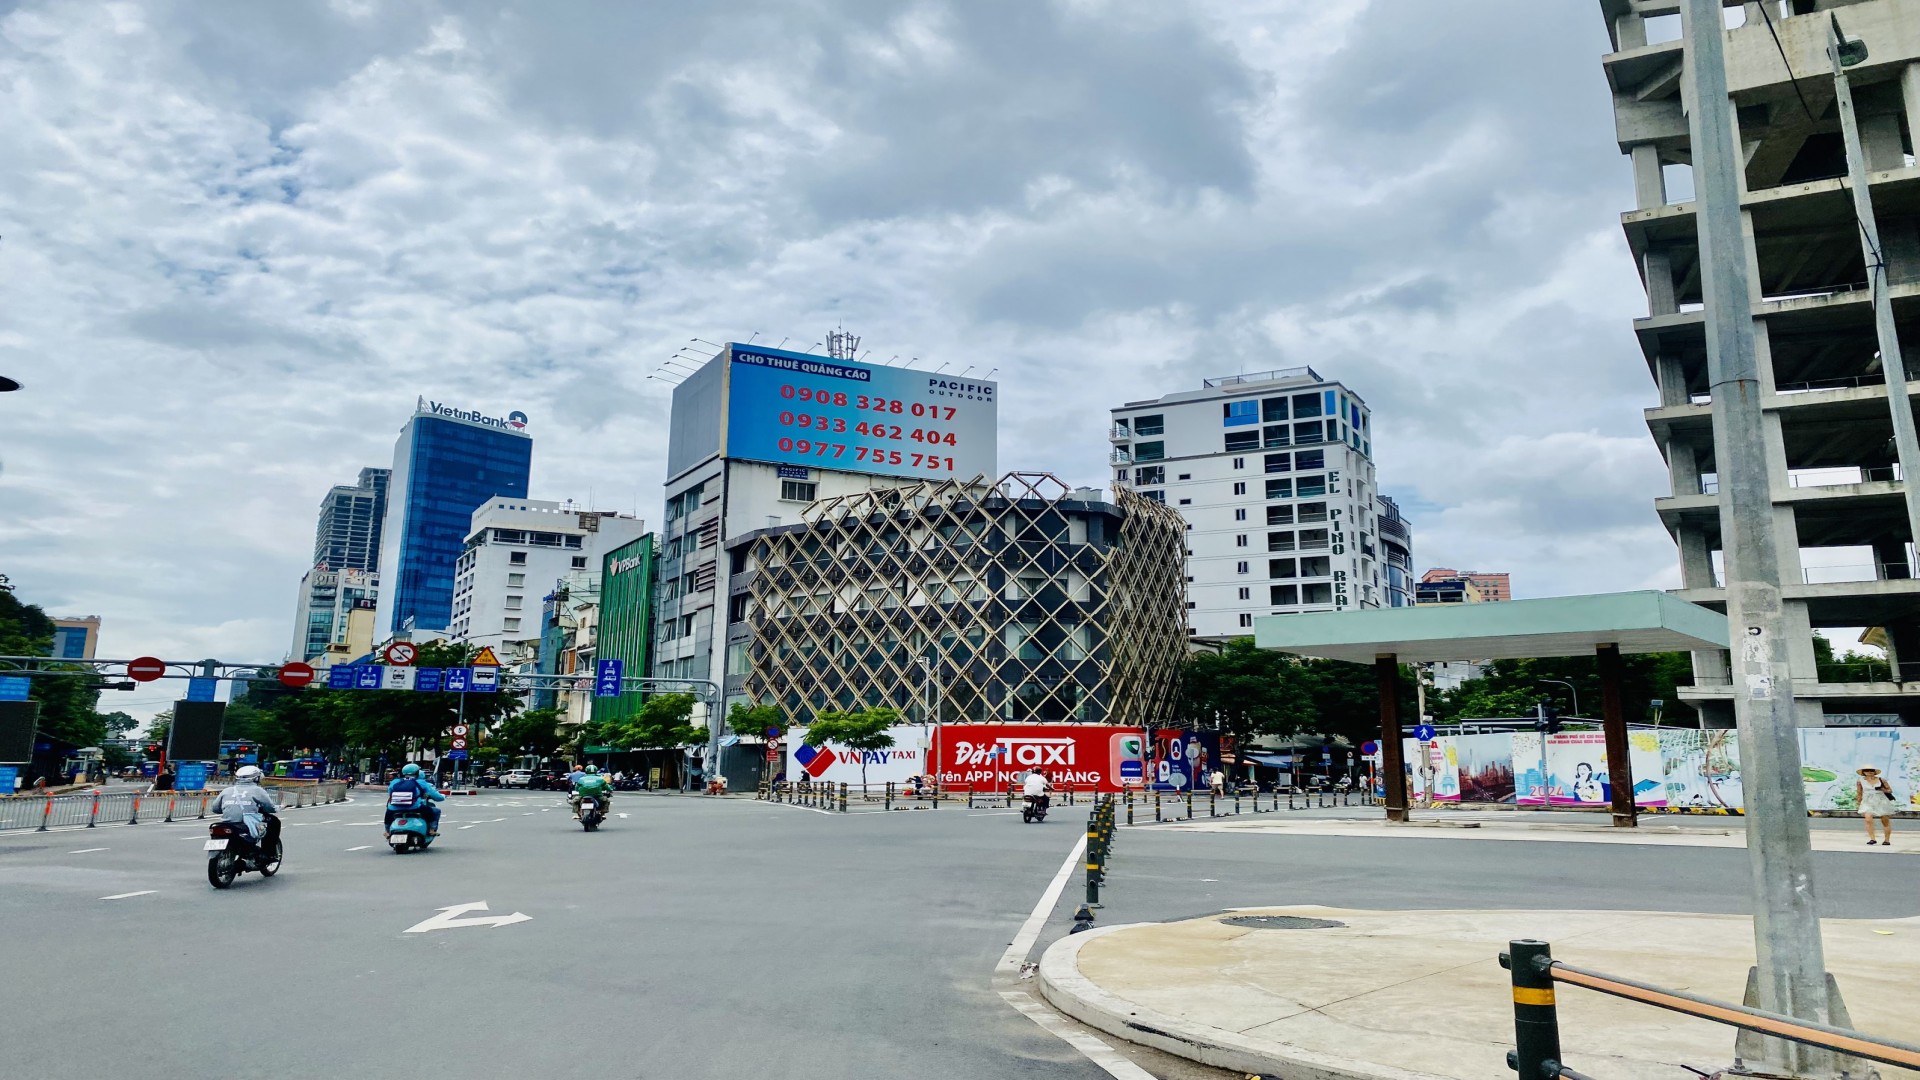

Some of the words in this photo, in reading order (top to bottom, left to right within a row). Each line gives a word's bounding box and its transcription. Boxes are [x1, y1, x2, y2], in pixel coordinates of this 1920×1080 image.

[739, 353, 764, 365] CHO
[766, 357, 799, 370] THUÊ
[801, 362, 843, 376] QUẢNG
[845, 368, 868, 380] CÁO
[929, 379, 992, 395] PACIFIC
[929, 389, 992, 403] OUTDOOR
[780, 384, 848, 407] 0908
[856, 395, 903, 414] 328
[911, 402, 957, 421] 017
[430, 400, 509, 430] VietinBank
[779, 411, 847, 433] 0933
[855, 421, 902, 440] 462
[910, 428, 957, 446] 404
[778, 437, 846, 458] 0977
[855, 446, 902, 465] 755
[911, 453, 954, 471] 751
[618, 554, 641, 574] VPBank
[838, 751, 890, 765] VNPAY
[892, 751, 916, 760] TAXI
[955, 741, 999, 769] Đặt
[996, 737, 1076, 765] Taxi
[935, 770, 961, 782] trên
[965, 771, 993, 782] APP
[1053, 769, 1101, 782] HÀNG
[1529, 785, 1565, 797] 2024
